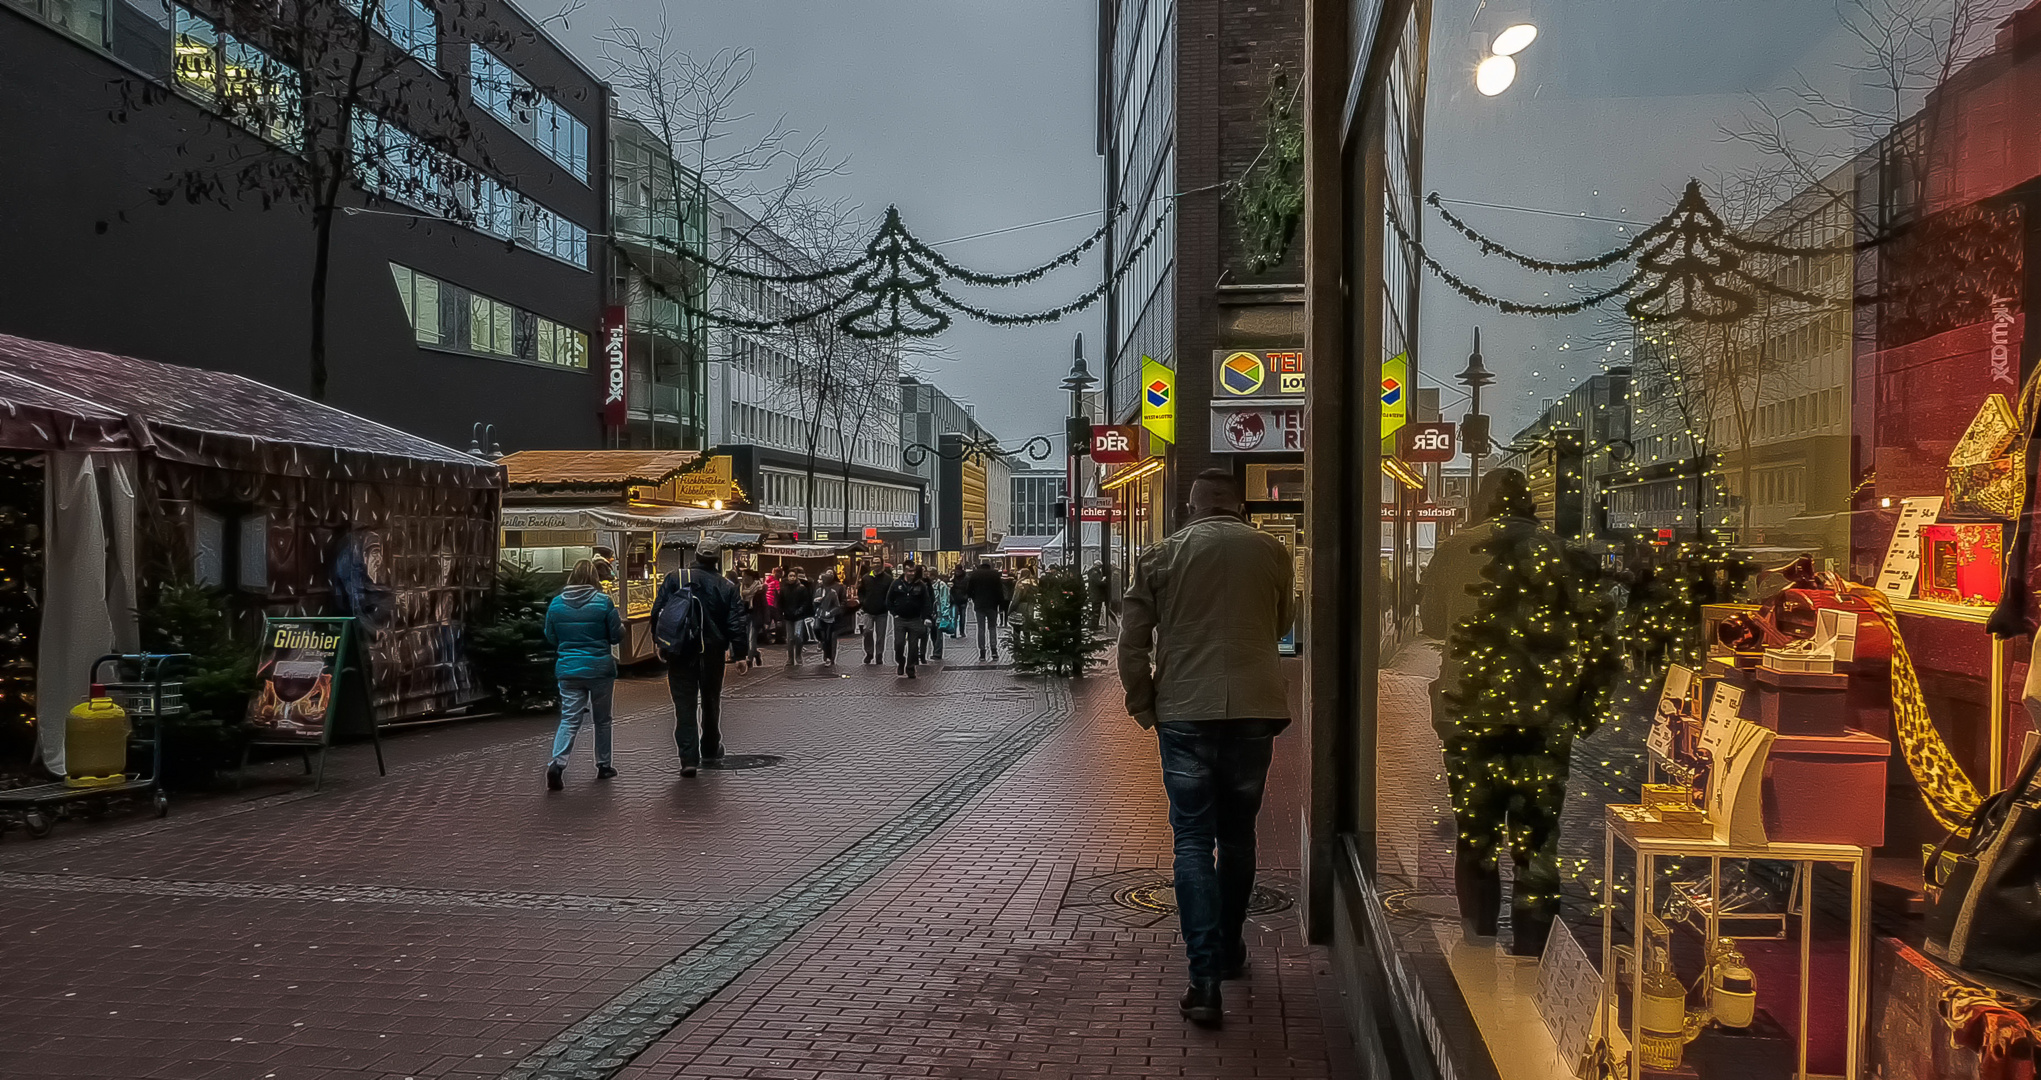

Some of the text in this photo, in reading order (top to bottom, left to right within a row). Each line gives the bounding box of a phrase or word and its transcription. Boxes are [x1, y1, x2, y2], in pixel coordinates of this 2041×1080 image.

[1096, 436, 1129, 451] DER
[528, 516, 566, 528] Backfisch
[274, 629, 341, 650] Glühbier
